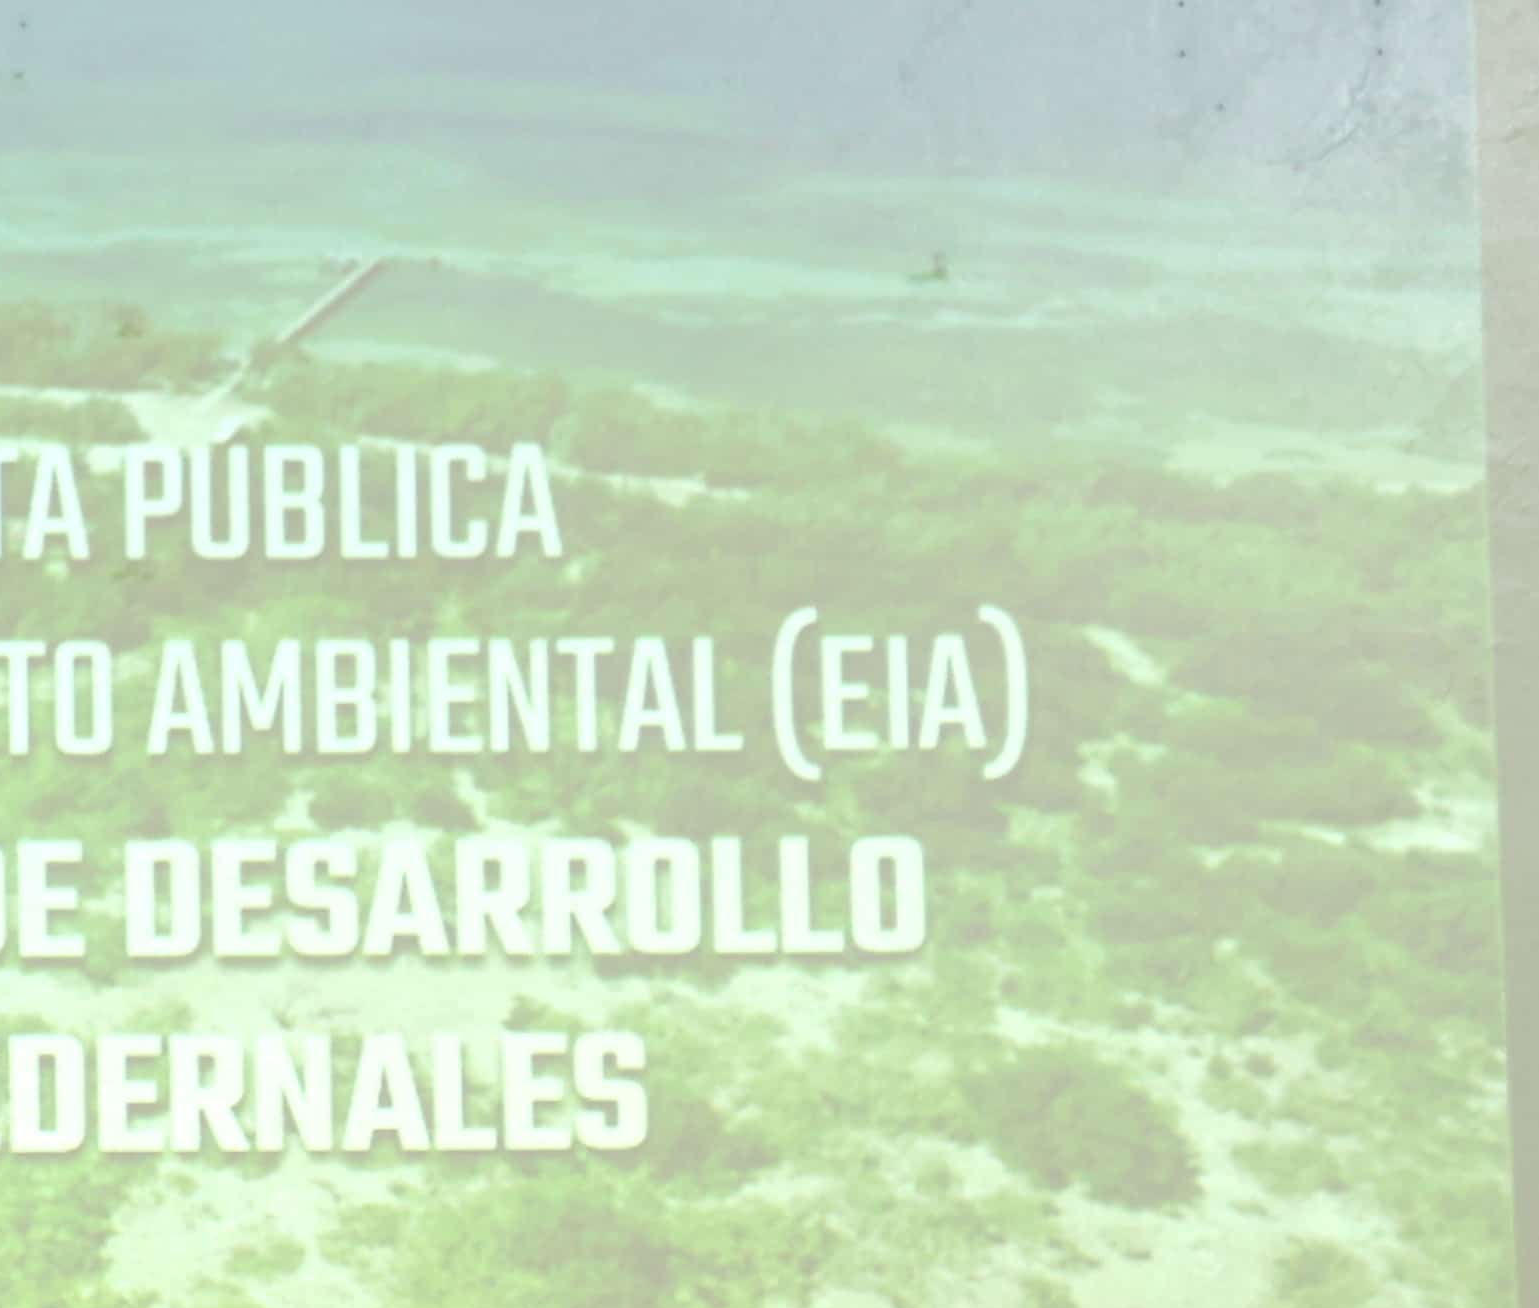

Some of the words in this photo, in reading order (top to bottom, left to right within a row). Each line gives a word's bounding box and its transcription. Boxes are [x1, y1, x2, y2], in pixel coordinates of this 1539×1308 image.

[146, 635, 744, 755] AMBIENTAL
[771, 604, 1029, 781] (EIA)
[125, 834, 927, 959] DESARROLLO
